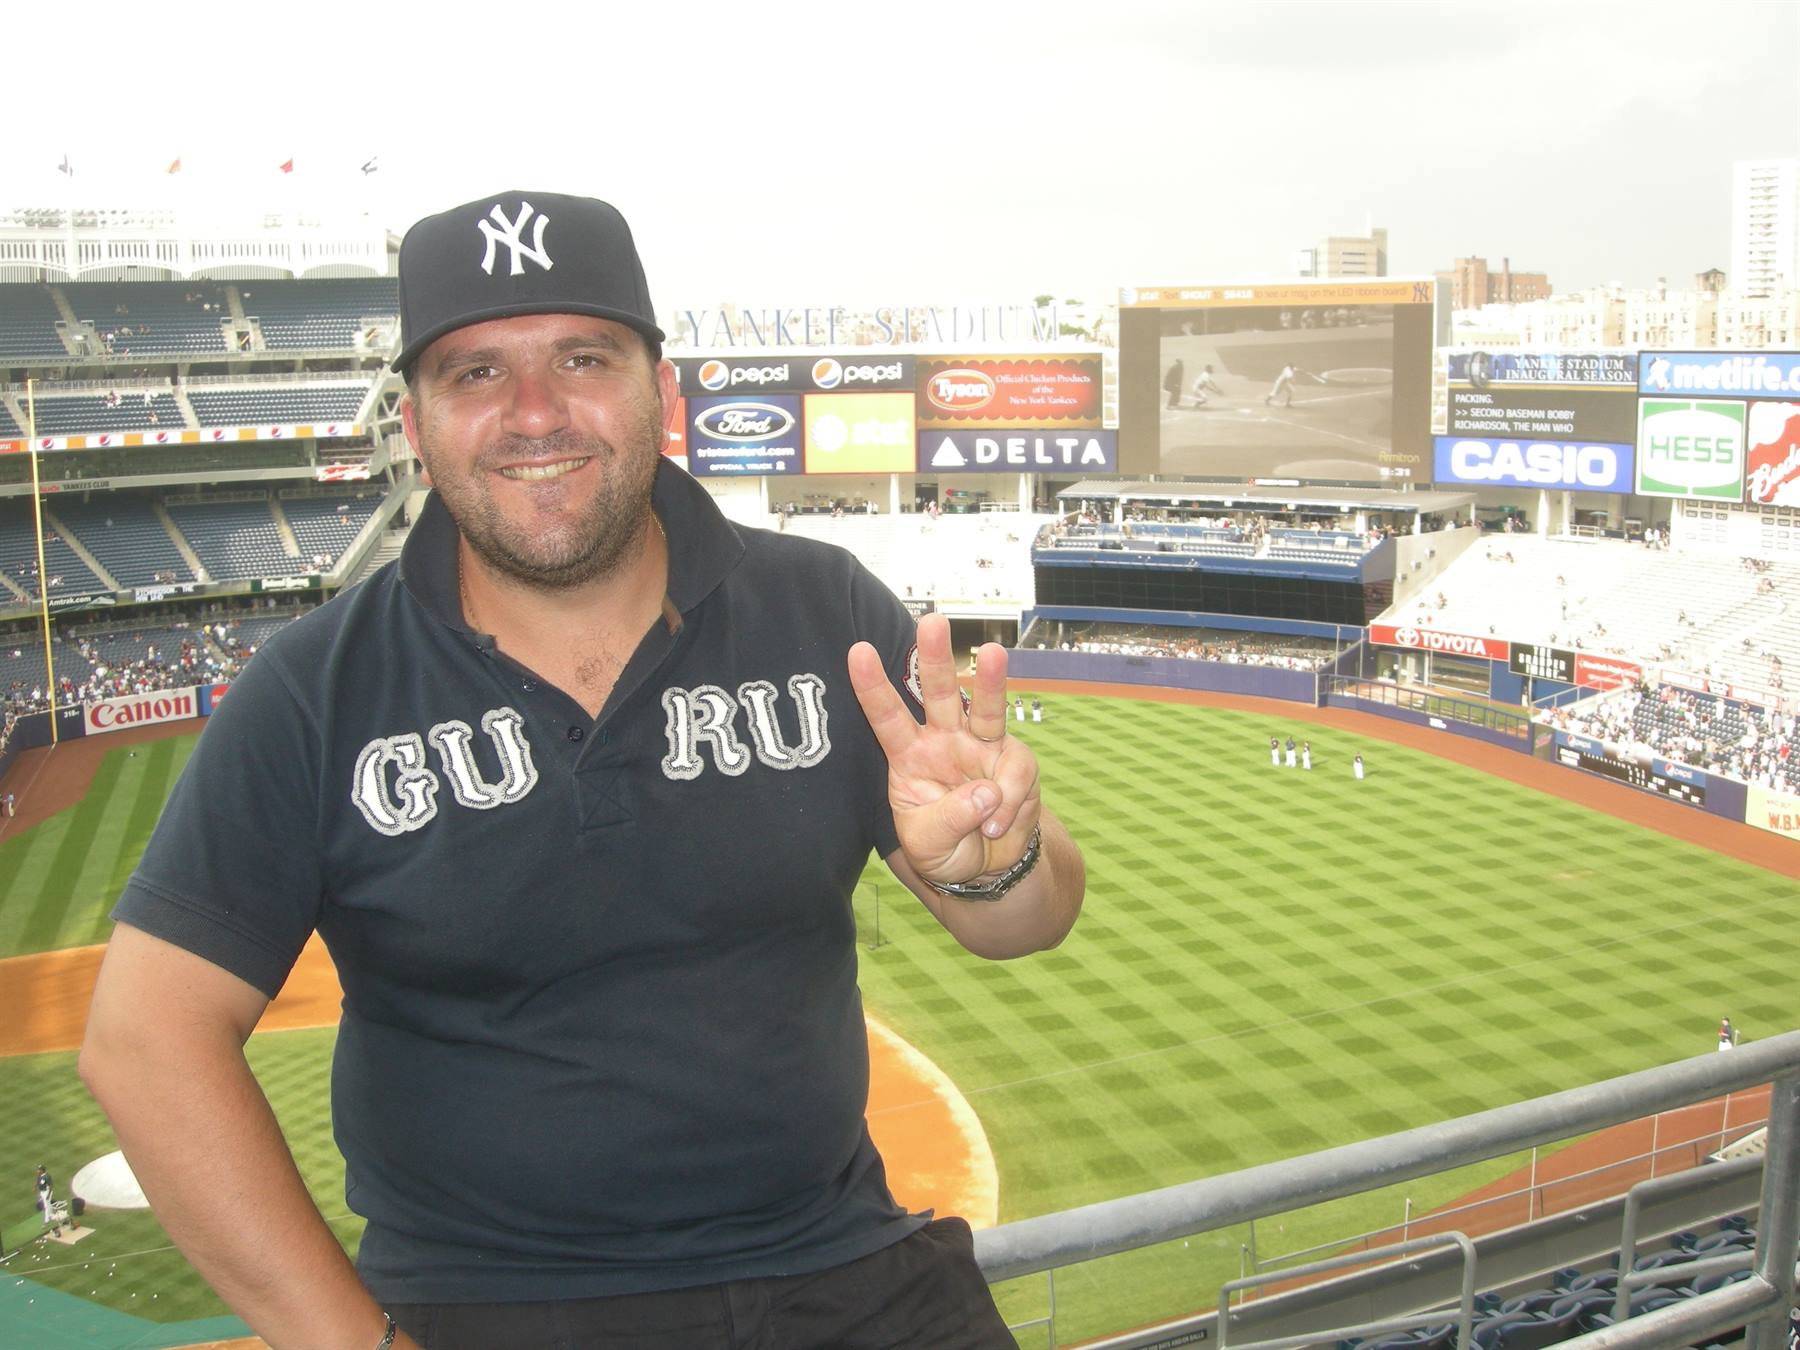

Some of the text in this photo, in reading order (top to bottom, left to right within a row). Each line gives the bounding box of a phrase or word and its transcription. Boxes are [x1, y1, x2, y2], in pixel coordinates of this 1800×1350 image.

[477, 200, 554, 277] NY
[685, 306, 848, 347] YANKEE
[730, 364, 790, 386] pepsi
[843, 362, 903, 384] pepsi
[1505, 368, 1634, 382] INAUGURAL SEASON
[1514, 357, 1625, 371] YANKEE STADIUM
[934, 378, 990, 403] Tyson
[1454, 393, 1495, 405] PACKING.
[717, 409, 772, 435] Ford
[1470, 408, 1505, 420] SECOND
[1506, 409, 1546, 421] BASEMAN
[1546, 410, 1576, 421] BOBBY
[1513, 421, 1532, 432] THE
[1532, 422, 1551, 433] MAN
[1551, 423, 1575, 433] WHO
[974, 437, 1107, 465] DELTA
[1649, 434, 1735, 464] HESS
[1450, 440, 1618, 487] CASIO
[1420, 630, 1488, 656] TOYOTA
[89, 694, 192, 729] Canon
